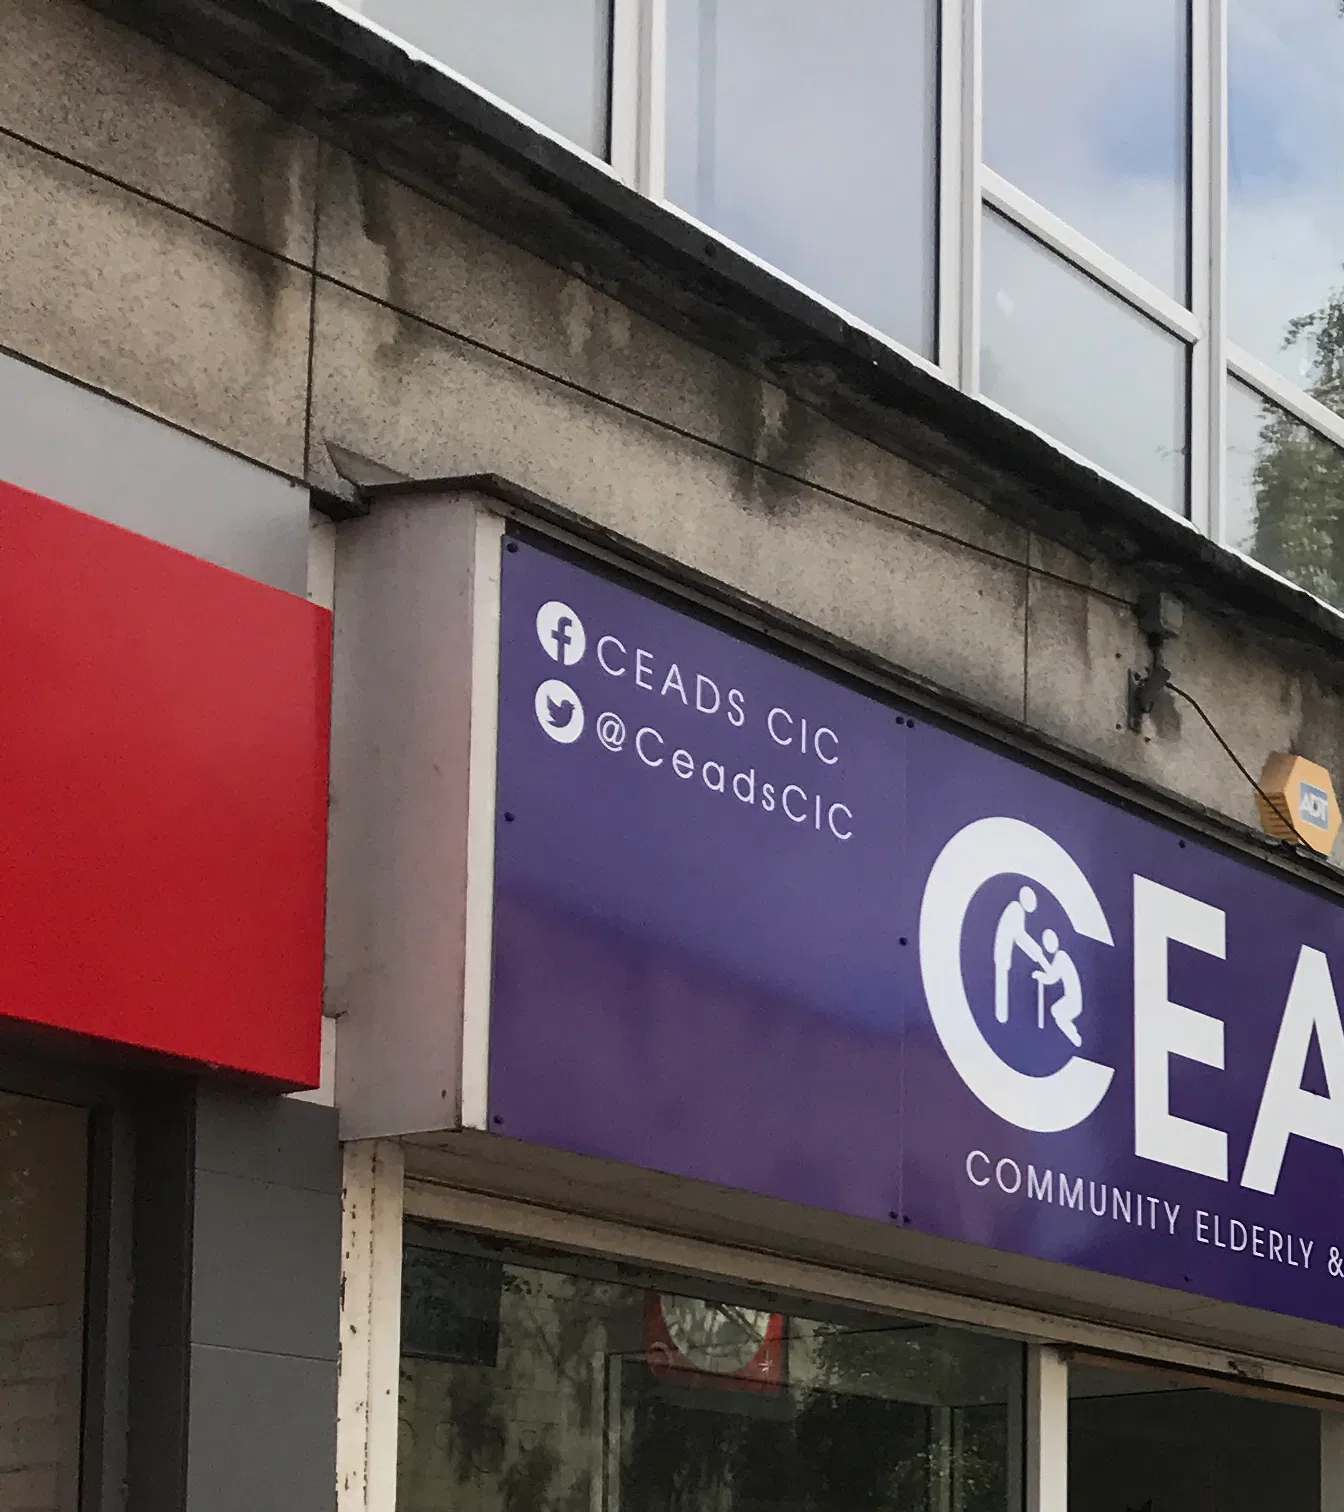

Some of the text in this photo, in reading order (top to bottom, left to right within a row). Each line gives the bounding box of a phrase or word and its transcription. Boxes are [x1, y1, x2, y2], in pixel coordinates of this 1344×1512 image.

[597, 635, 839, 765] CEADS CIC
[596, 711, 853, 840] @CeadsCIC
[966, 1150, 1180, 1235] COMMUNITY
[1196, 1210, 1314, 1269] ELDERLY
[1327, 1246, 1344, 1278] &
